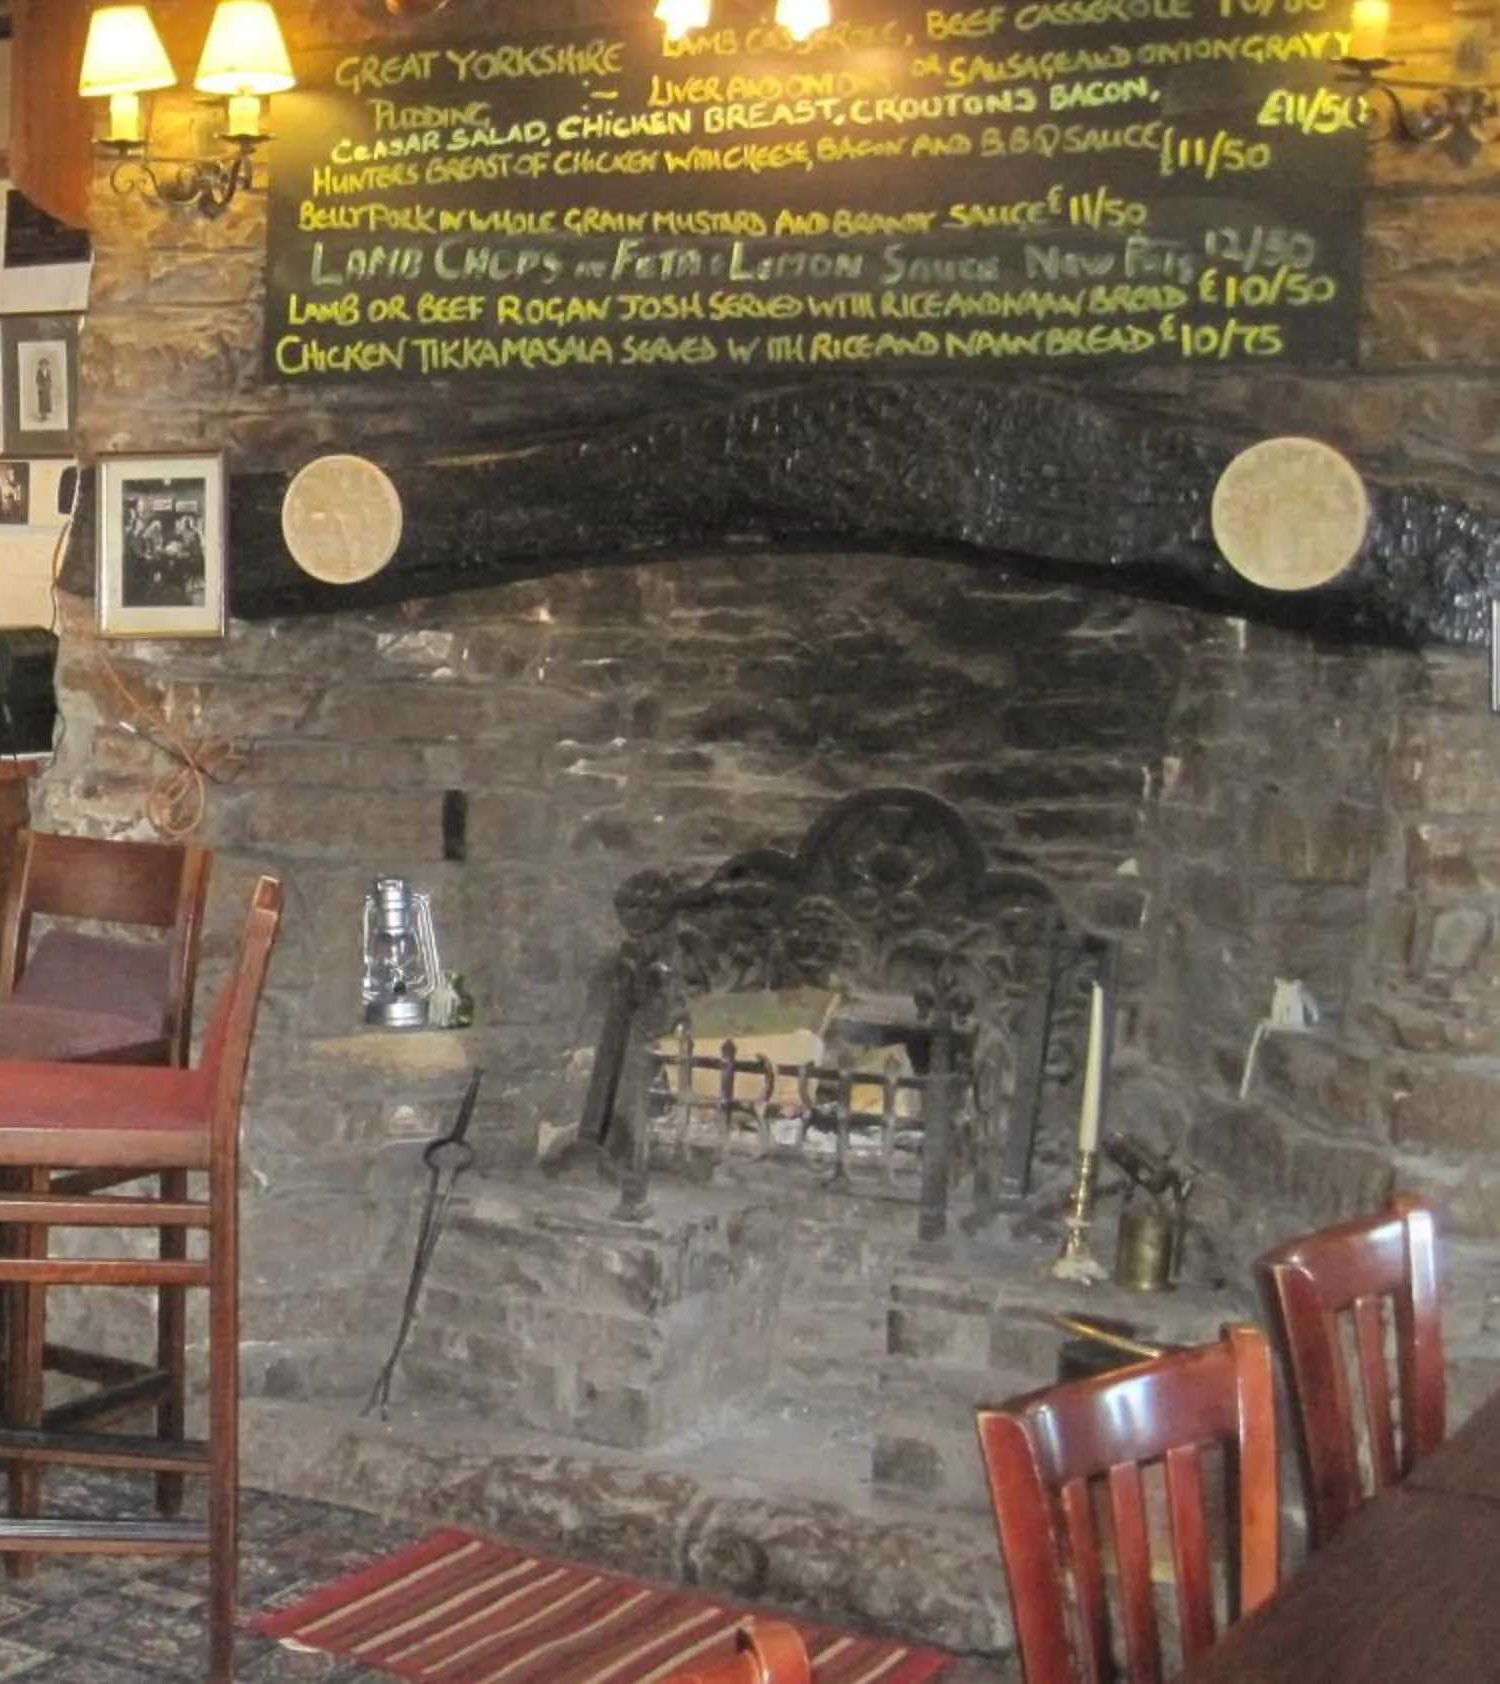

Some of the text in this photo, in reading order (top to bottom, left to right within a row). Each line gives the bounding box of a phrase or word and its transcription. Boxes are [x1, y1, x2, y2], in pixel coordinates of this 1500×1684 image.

[925, 5, 1005, 40] BEEF
[335, 40, 626, 95] GREAT YORKSHIRE
[647, 74, 724, 107] LIVER
[726, 73, 783, 100] AND
[946, 51, 1077, 87] SAUSAGE
[1076, 44, 1132, 71] AND
[1136, 36, 1241, 63] ONION
[1242, 31, 1352, 62] GRAVY
[368, 97, 492, 133] PUDDING
[446, 120, 551, 150] SALAD,
[704, 96, 845, 134] BREAST,
[1049, 76, 1162, 112] BACON,
[1256, 86, 1369, 135] £11/50
[425, 153, 509, 185] BREAST
[513, 150, 550, 180] OF
[553, 149, 660, 176] CHICKEN
[816, 134, 908, 163] BACON
[911, 132, 972, 158] AND
[1062, 120, 1163, 151] SAUCE
[297, 200, 366, 232] BELLY
[362, 202, 437, 234] PORK
[468, 208, 558, 236] WHOLE
[563, 207, 649, 237] GRAIN
[652, 209, 768, 238] MUSTARD
[774, 208, 830, 238] AND
[833, 208, 937, 239] BRANDY
[942, 200, 1049, 233] SAUCE
[1204, 224, 1317, 273] 12/50
[287, 292, 361, 326] LAMB
[366, 294, 411, 324] OR
[416, 291, 486, 324] BEEF
[497, 294, 612, 328] ROGAN
[616, 291, 705, 321] JOSH
[880, 289, 944, 320] RICE
[944, 290, 1001, 319] AND
[1086, 284, 1189, 314] BREAD
[1198, 264, 1337, 309] £10/50
[275, 334, 407, 375] CHICKEN
[409, 335, 502, 375] TIKKA
[501, 334, 614, 369] MASALA
[809, 331, 875, 364] RICE
[874, 331, 941, 357] AND
[1045, 324, 1156, 357] BREAD
